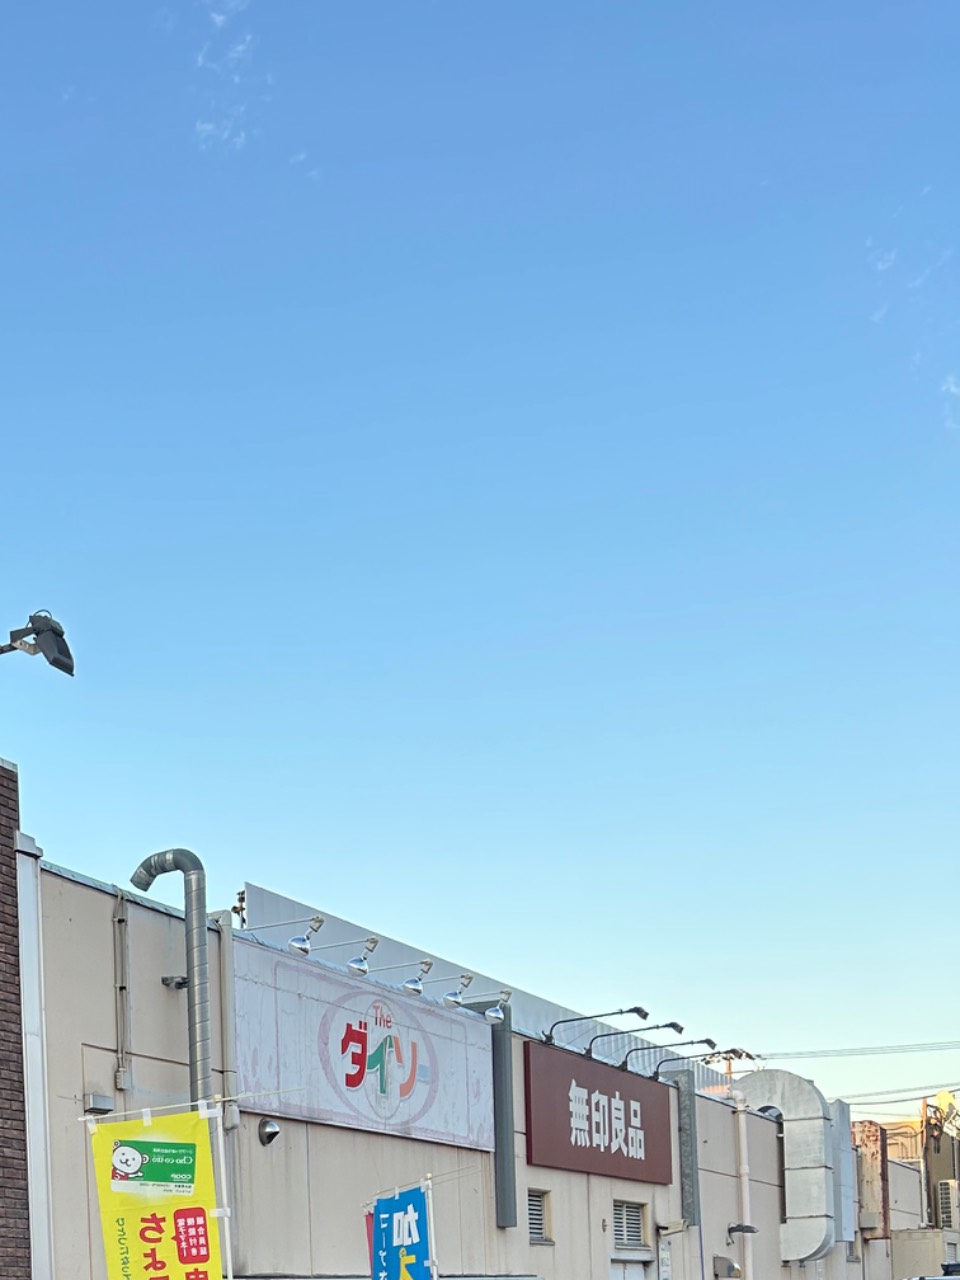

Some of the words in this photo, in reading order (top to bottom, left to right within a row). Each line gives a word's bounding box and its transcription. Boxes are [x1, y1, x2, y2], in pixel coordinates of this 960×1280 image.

[372, 1004, 393, 1029] The
[568, 1078, 645, 1161] 無印良品
